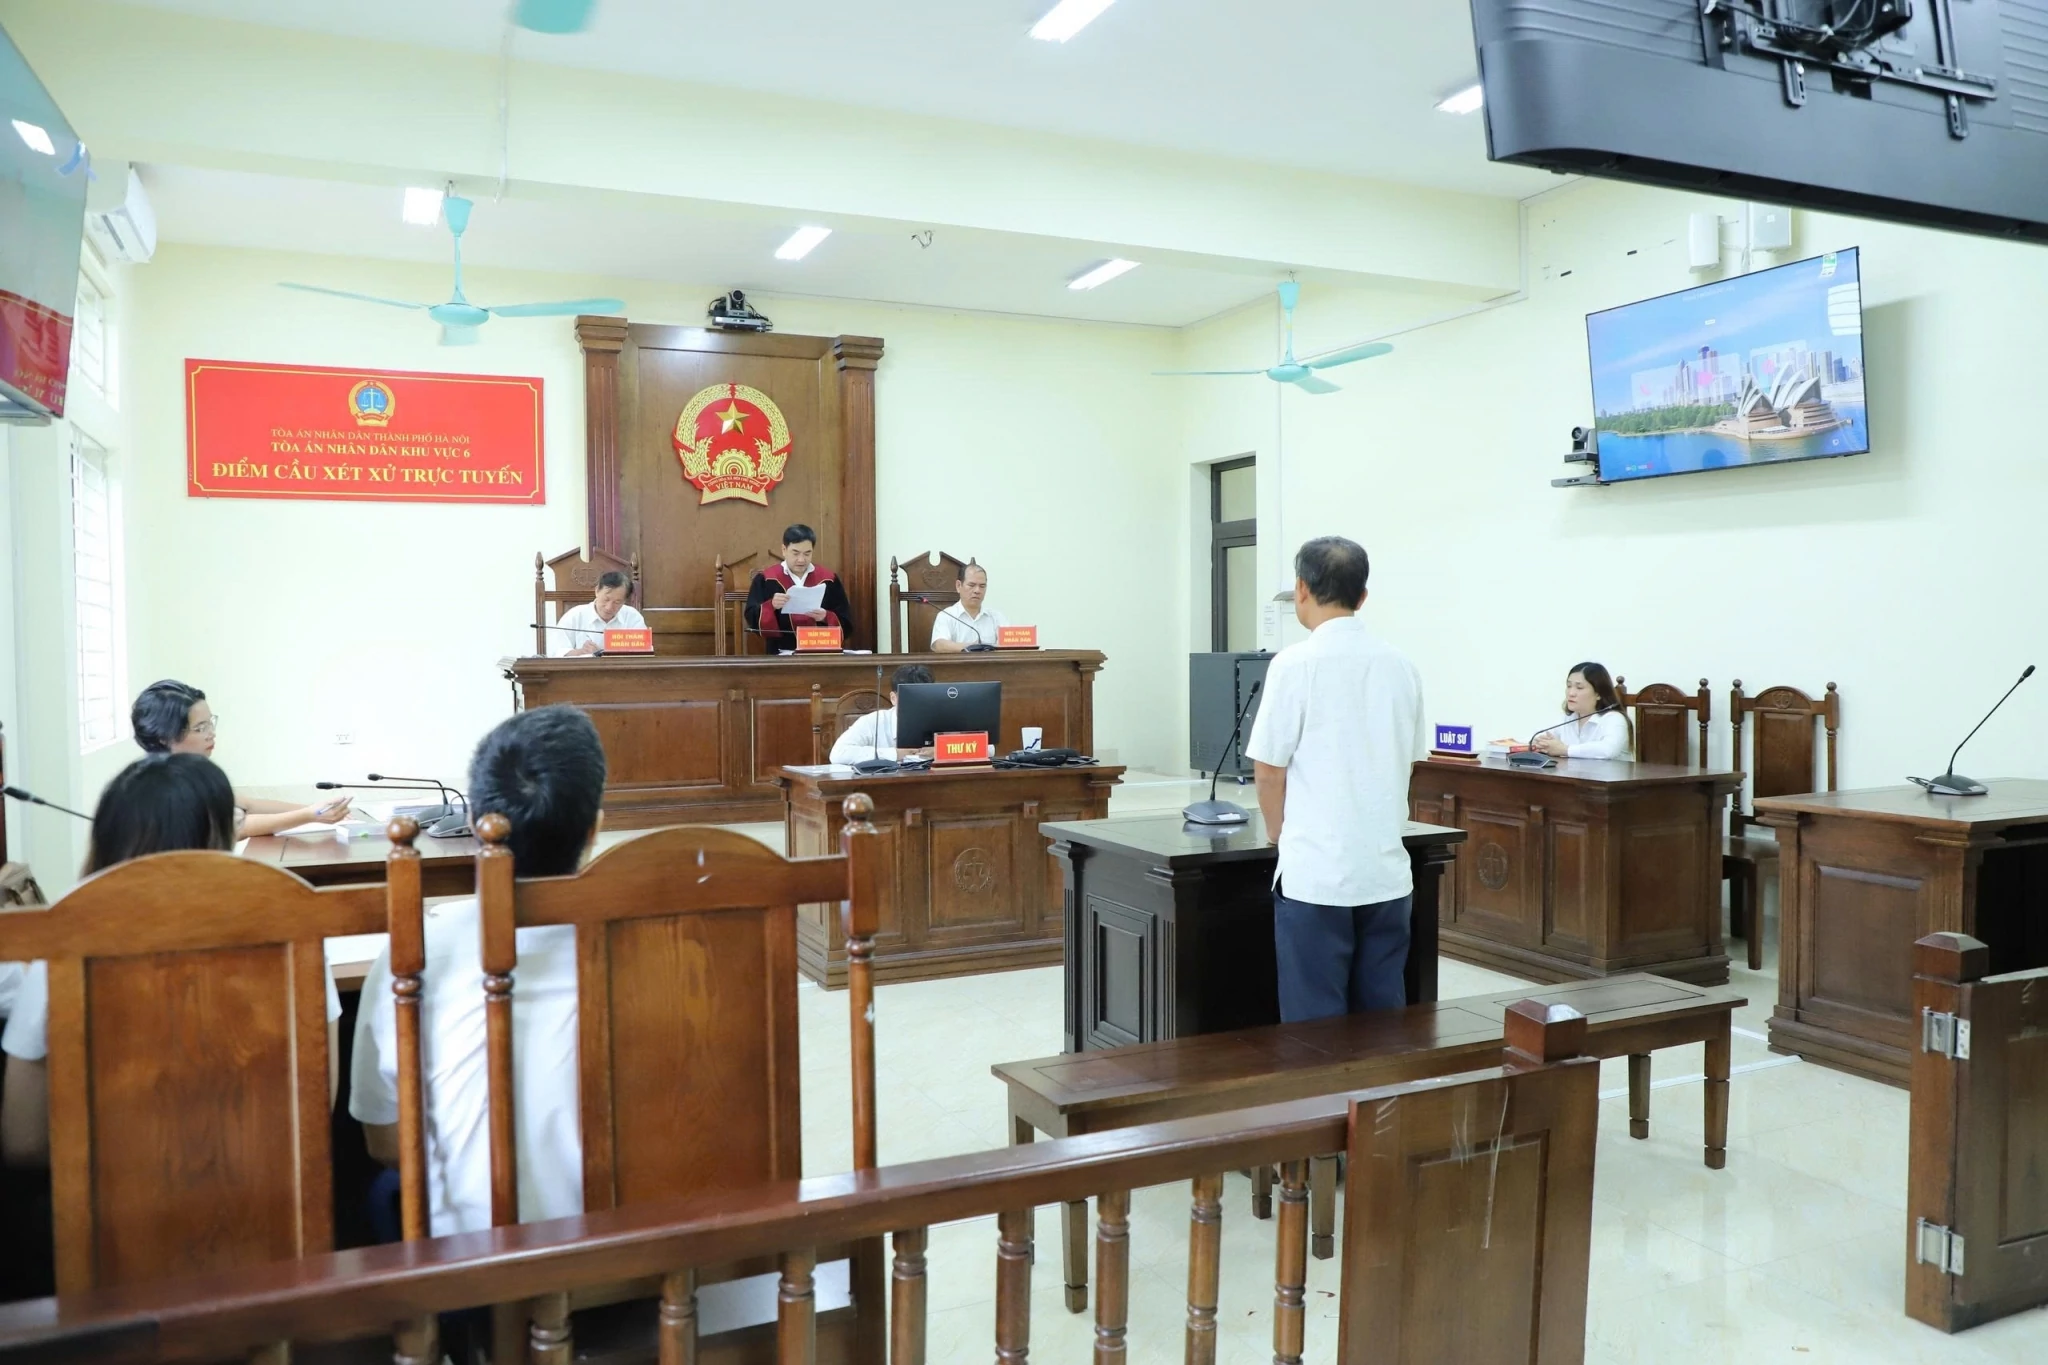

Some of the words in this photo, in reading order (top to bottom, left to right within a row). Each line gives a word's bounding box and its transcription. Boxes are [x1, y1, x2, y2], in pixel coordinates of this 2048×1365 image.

[271, 428, 293, 438] TÒA
[297, 428, 312, 438] ÁN
[314, 429, 345, 440] NHÂN
[348, 430, 370, 441] DÂN
[374, 431, 409, 442] THÀNH
[412, 431, 433, 443] PHỐ
[435, 432, 449, 443] HÀ
[452, 433, 470, 445] NỘI
[271, 440, 300, 452] TÒA
[304, 440, 323, 453] ÁN
[327, 441, 366, 455] NHÂN
[369, 443, 398, 456] DÂN
[401, 446, 430, 457] KHU
[433, 447, 461, 459] VỰC
[463, 448, 471, 458] 6
[212, 456, 269, 479] ĐIỂM
[274, 458, 317, 480] CẦU
[323, 463, 363, 481] XÉT
[368, 463, 396, 482] XỬ
[400, 467, 454, 486] TRỰC
[458, 464, 523, 485] TUYẾN
[1439, 730, 1456, 746] LUẬT
[1456, 733, 1468, 745] SƯ
[946, 742, 964, 754] THƯ
[965, 741, 978, 754] KÝ
